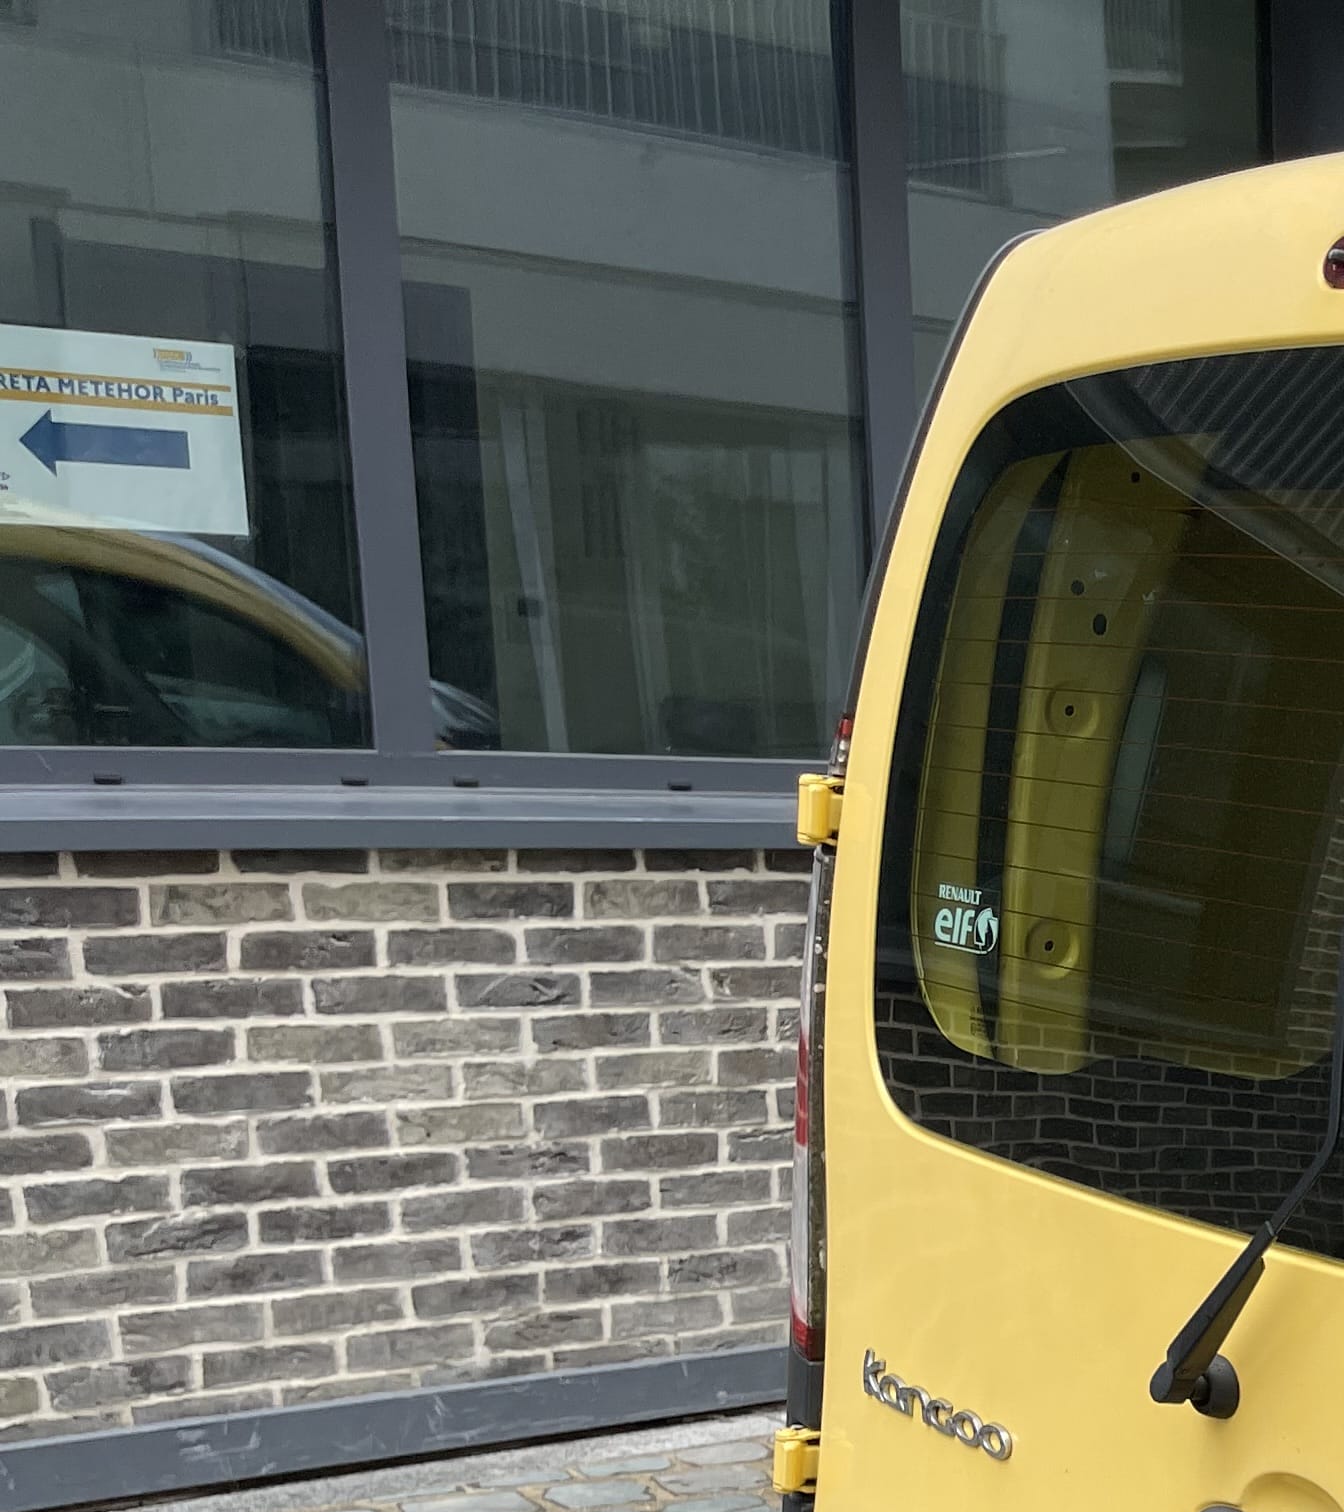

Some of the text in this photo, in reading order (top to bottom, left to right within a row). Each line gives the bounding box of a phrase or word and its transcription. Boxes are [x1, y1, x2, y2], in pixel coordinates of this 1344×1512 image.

[58, 379, 165, 401] METEHOR
[172, 388, 219, 406] Paris
[938, 883, 982, 905] RENAULT
[934, 907, 975, 945] elf
